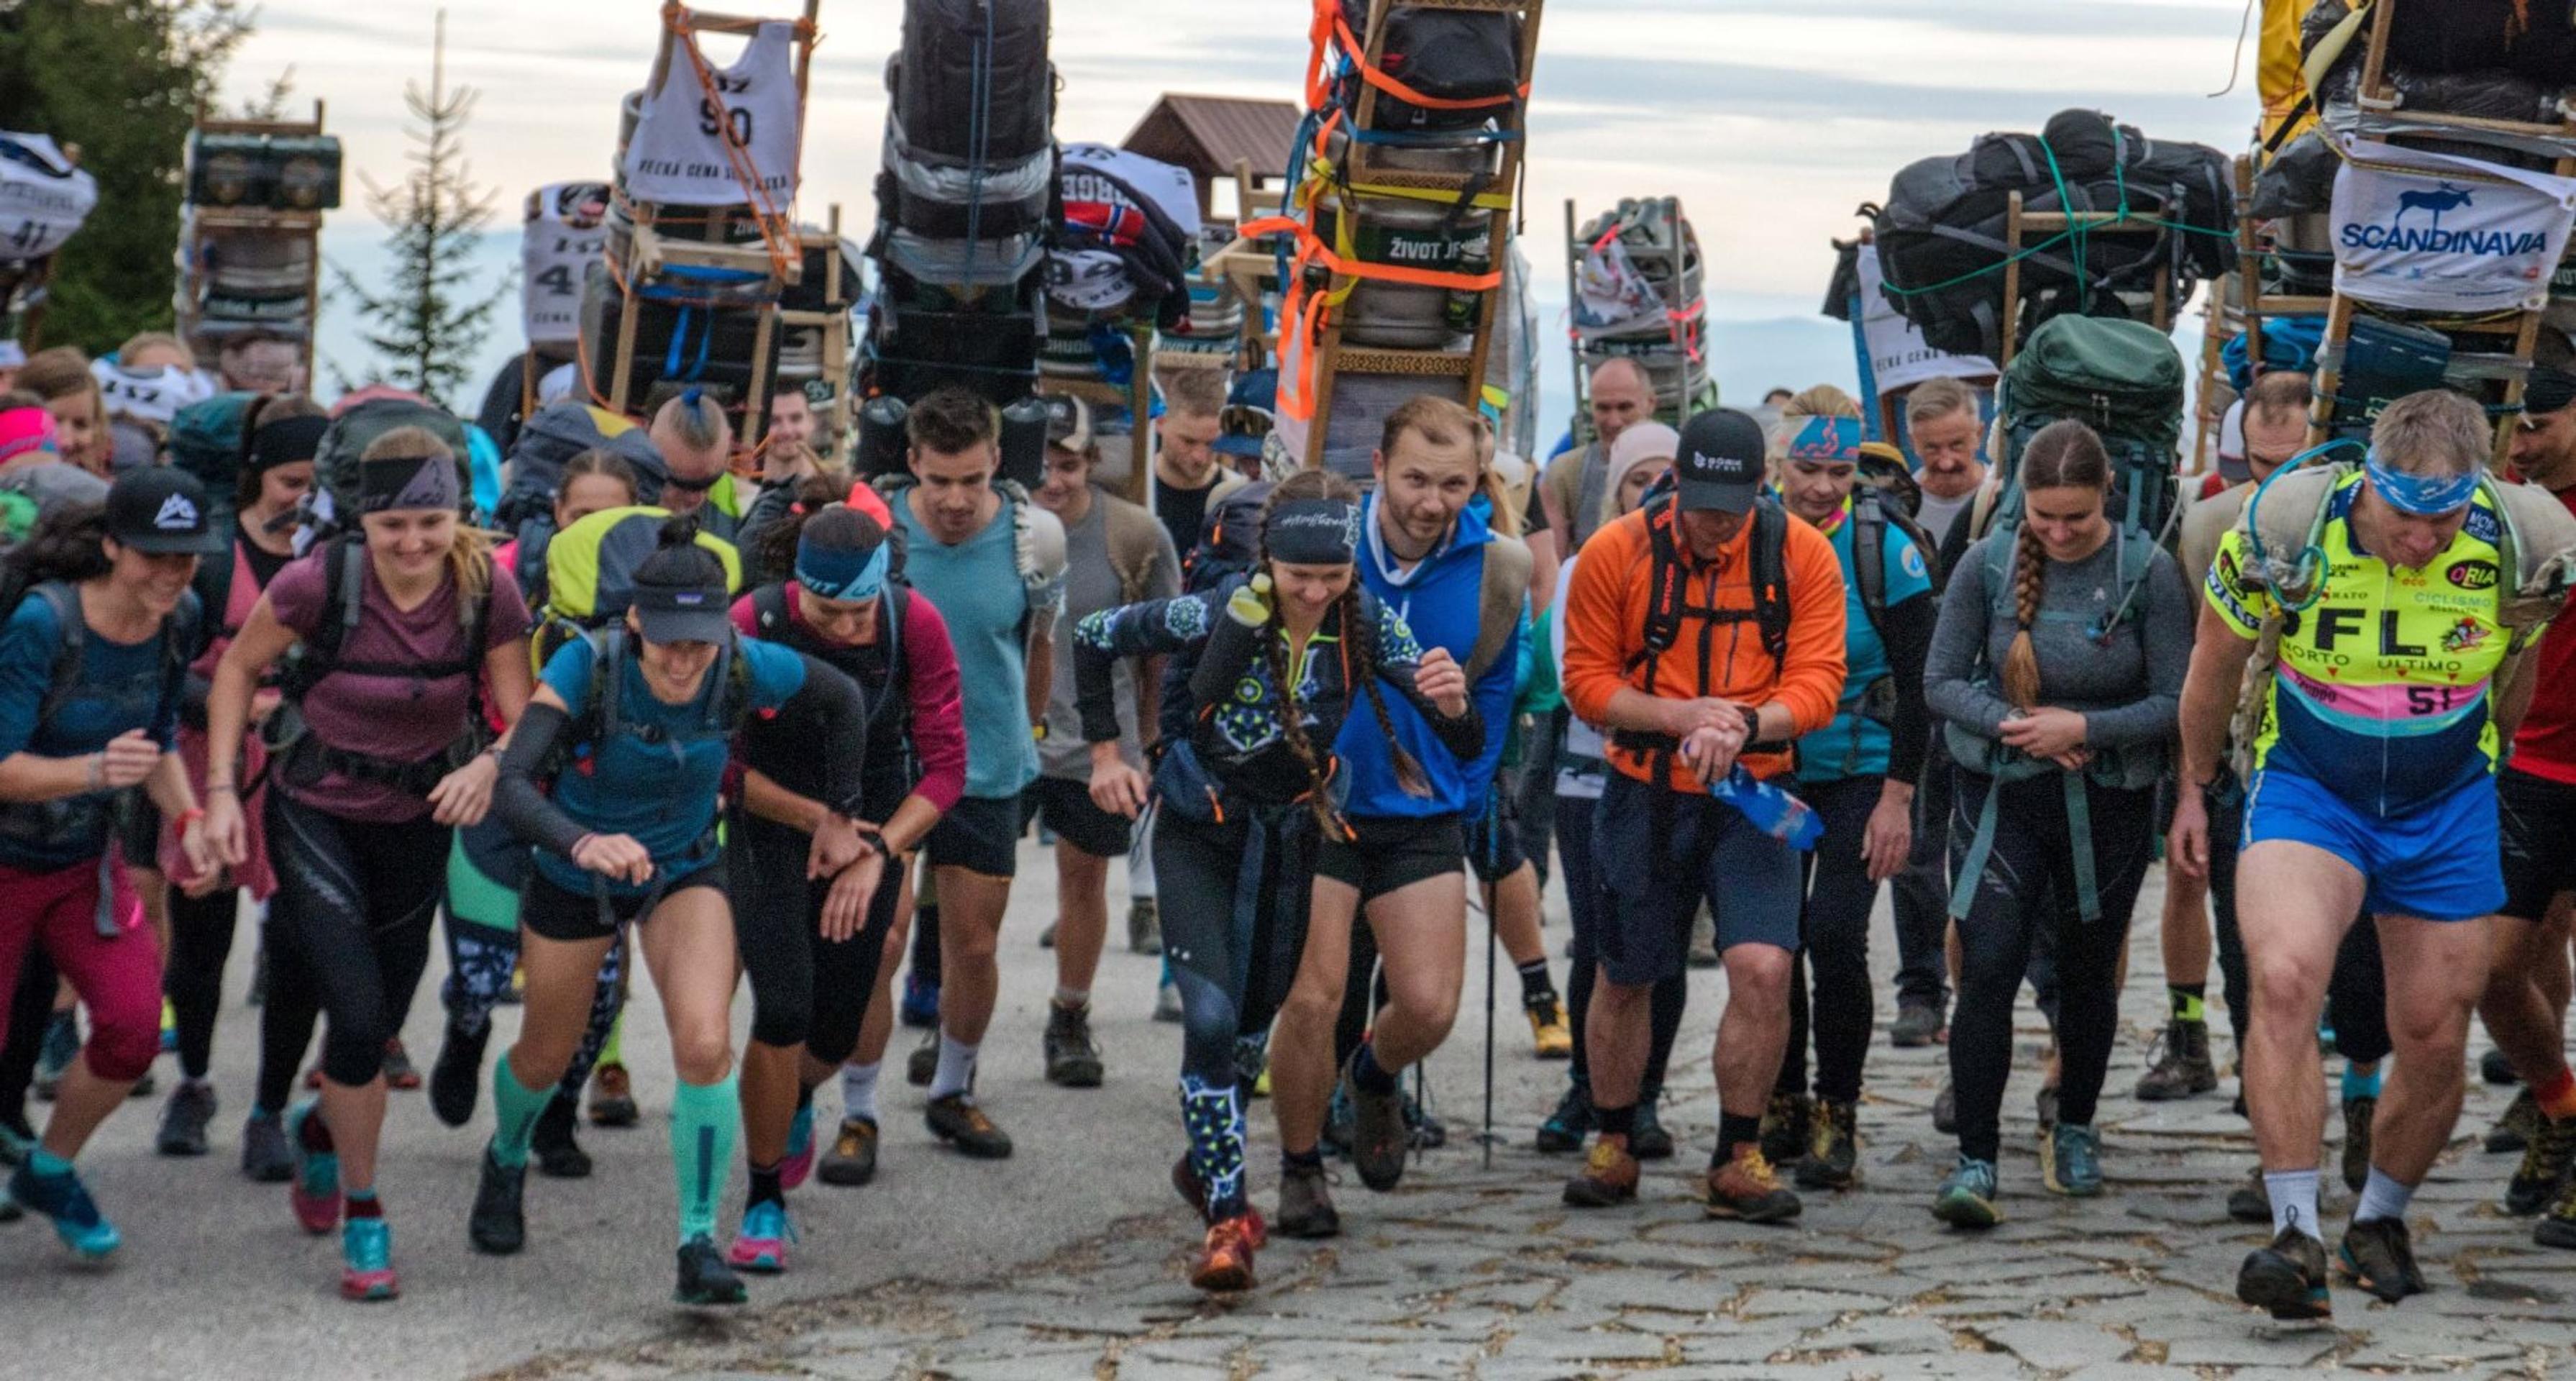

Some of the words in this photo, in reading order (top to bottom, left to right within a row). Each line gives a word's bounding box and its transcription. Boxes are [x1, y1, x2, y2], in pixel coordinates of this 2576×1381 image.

[687, 163, 719, 178] CENA
[2340, 222, 2546, 256] SCANDINAVIA
[1390, 237, 1441, 260] ŽIVOT
[2414, 592, 2491, 608] CICLISMO
[2378, 658, 2462, 672] ULTIMO
